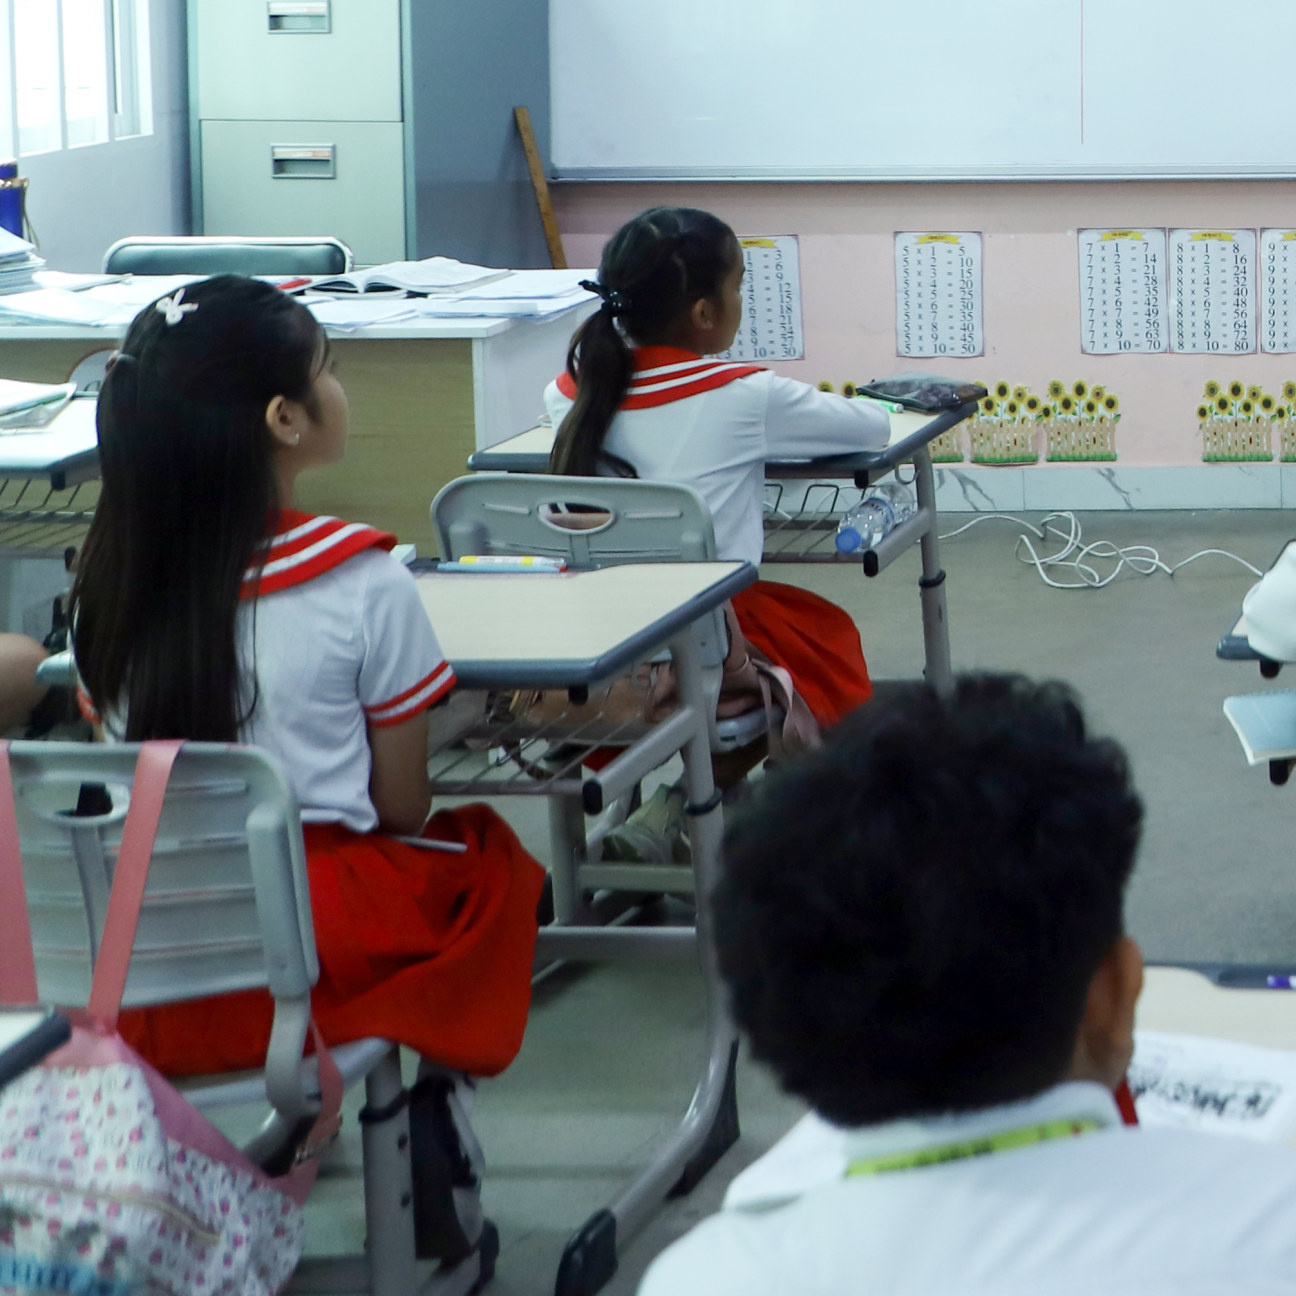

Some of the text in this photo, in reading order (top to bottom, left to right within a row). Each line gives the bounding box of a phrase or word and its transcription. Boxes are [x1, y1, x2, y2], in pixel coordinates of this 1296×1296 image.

[902, 246, 909, 256] 5
[931, 246, 936, 256] 1
[958, 246, 965, 256] 5
[1086, 243, 1093, 253] 7
[1114, 243, 1119, 253] 1
[1142, 243, 1149, 253] 7
[1177, 243, 1184, 253] 8
[1204, 243, 1209, 253] 1
[1232, 243, 1240, 253] 8
[1268, 243, 1276, 253] 9
[1177, 254, 1184, 264] 8
[1203, 254, 1210, 264] 2
[1234, 254, 1247, 264] 16
[1268, 254, 1276, 264] 9
